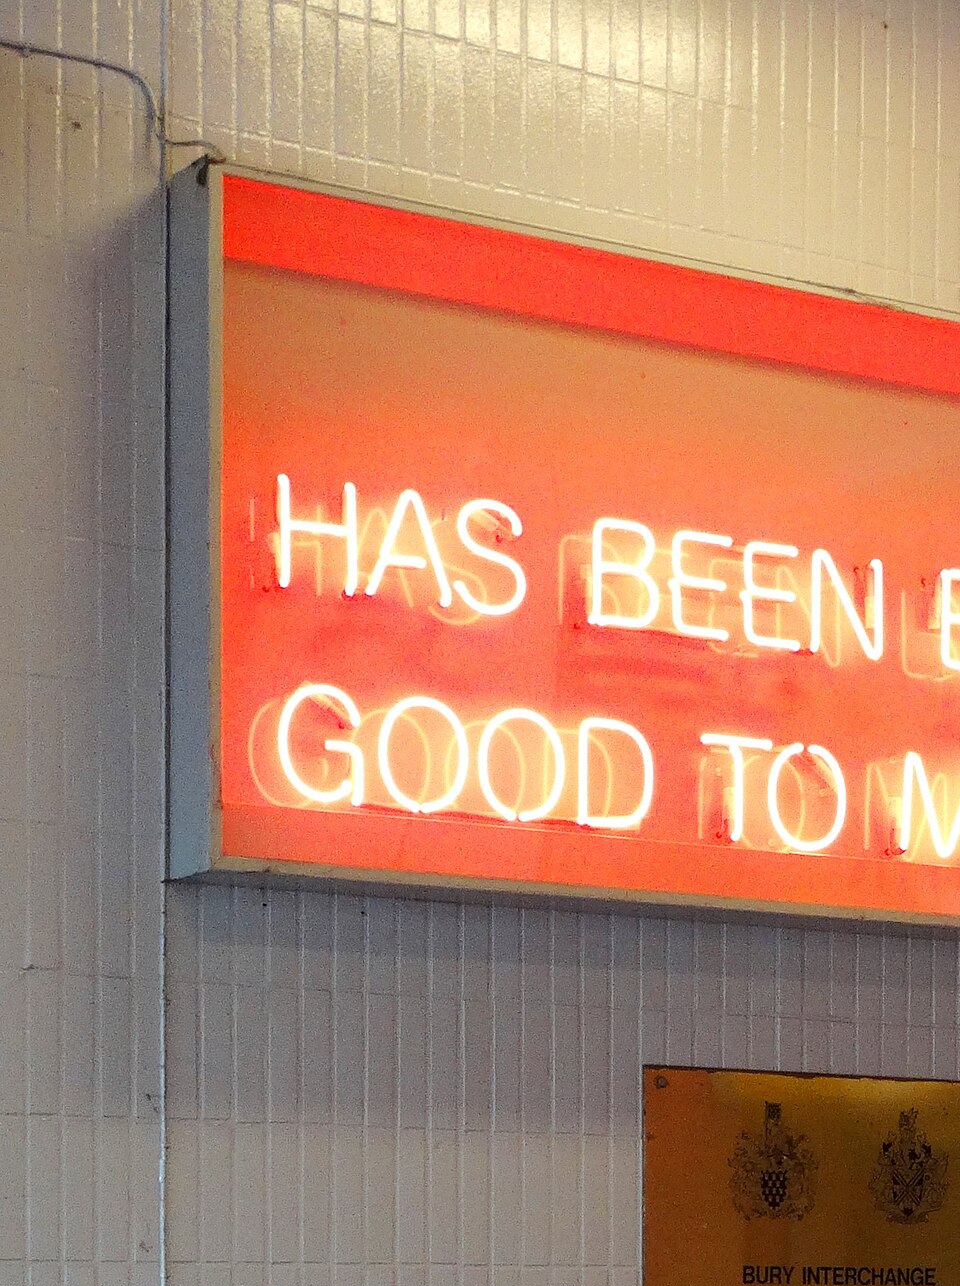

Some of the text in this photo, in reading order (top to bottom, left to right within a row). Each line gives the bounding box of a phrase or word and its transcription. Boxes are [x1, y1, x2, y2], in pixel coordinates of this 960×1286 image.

[276, 472, 528, 616] HAS
[587, 517, 884, 661] BEEN
[276, 683, 655, 829] GOOD
[699, 732, 848, 852] TO
[741, 1265, 937, 1286] BURY INTERCHANGE
